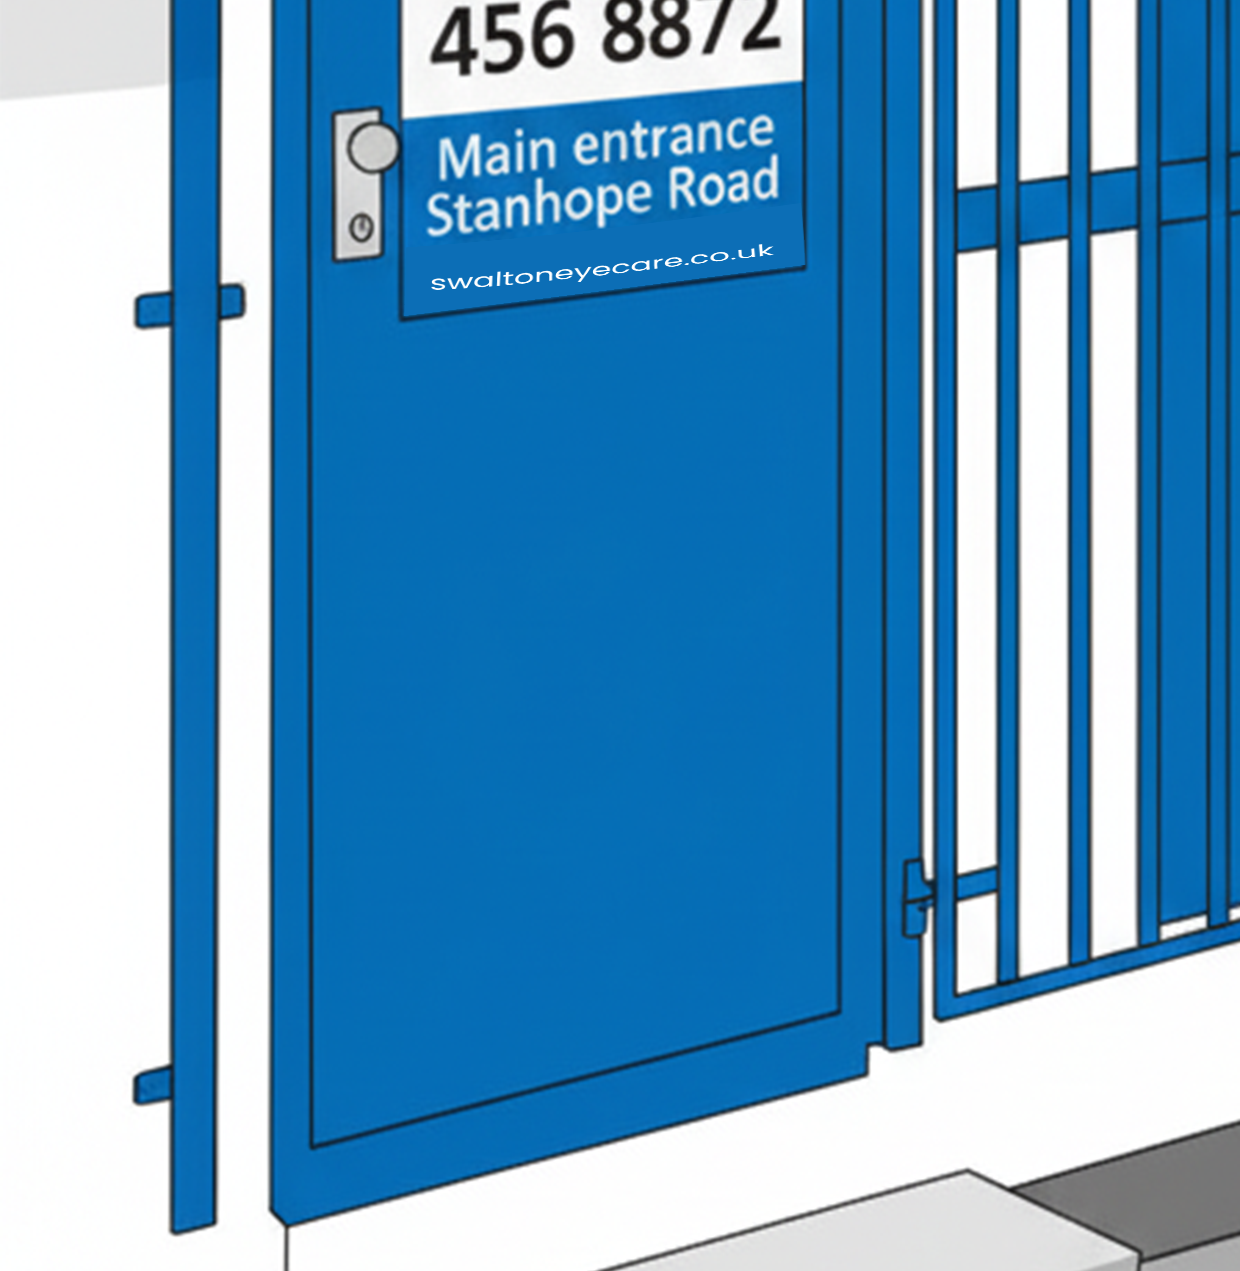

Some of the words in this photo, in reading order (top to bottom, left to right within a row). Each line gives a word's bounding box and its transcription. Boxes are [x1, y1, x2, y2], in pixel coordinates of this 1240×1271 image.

[439, 129, 555, 181] Main
[574, 115, 775, 166] entrance
[427, 178, 652, 236] Stanhope
[669, 154, 778, 210] Road
[430, 243, 774, 291] swaltoneyecare.co.uk
